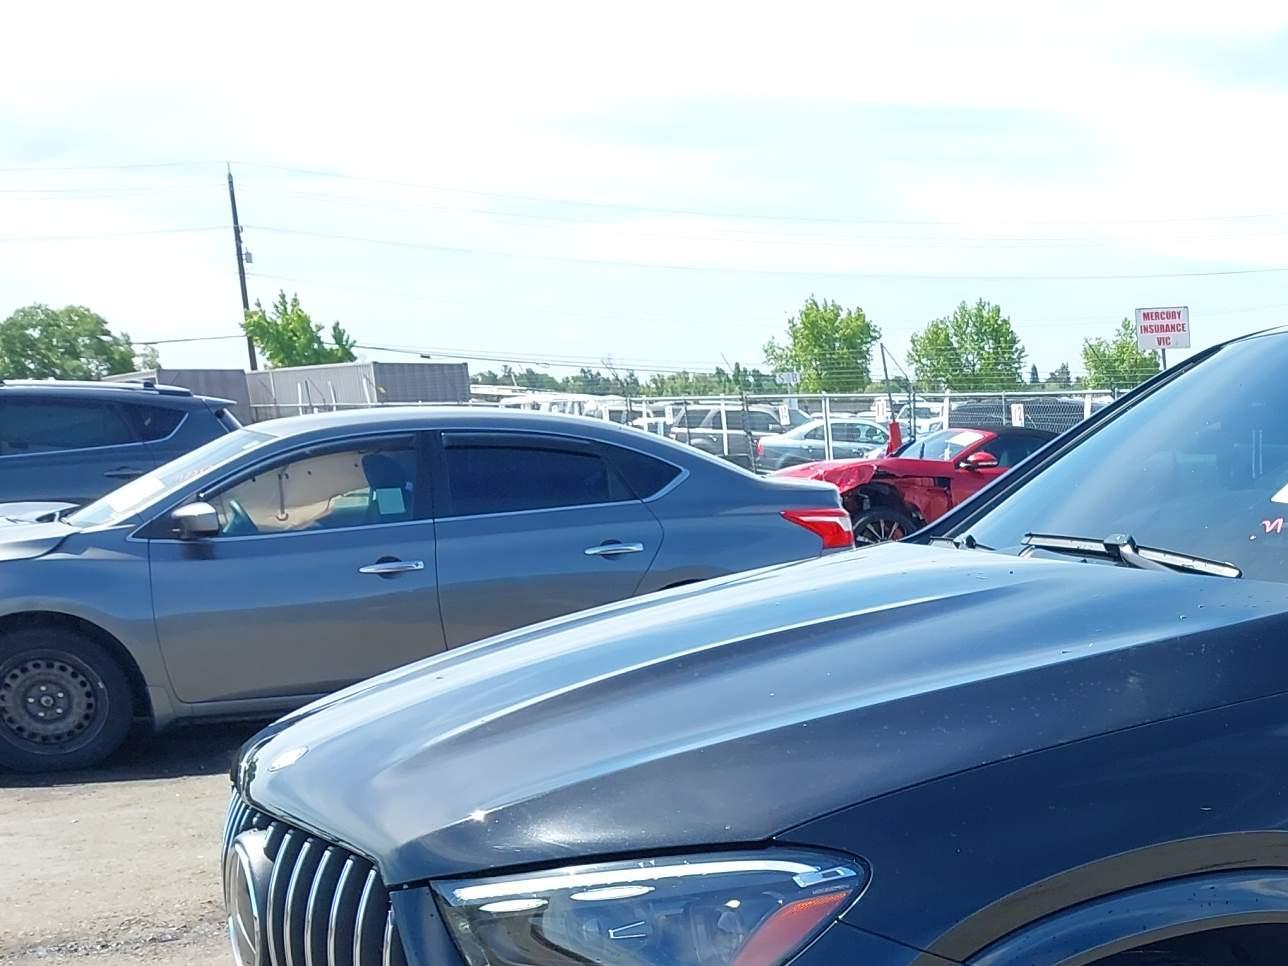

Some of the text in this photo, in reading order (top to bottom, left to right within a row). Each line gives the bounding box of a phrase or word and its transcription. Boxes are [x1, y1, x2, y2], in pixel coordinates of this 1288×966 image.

[1142, 311, 1181, 321] MERCURY
[1140, 323, 1187, 333] INSURANCE
[1156, 336, 1171, 346] VIC
